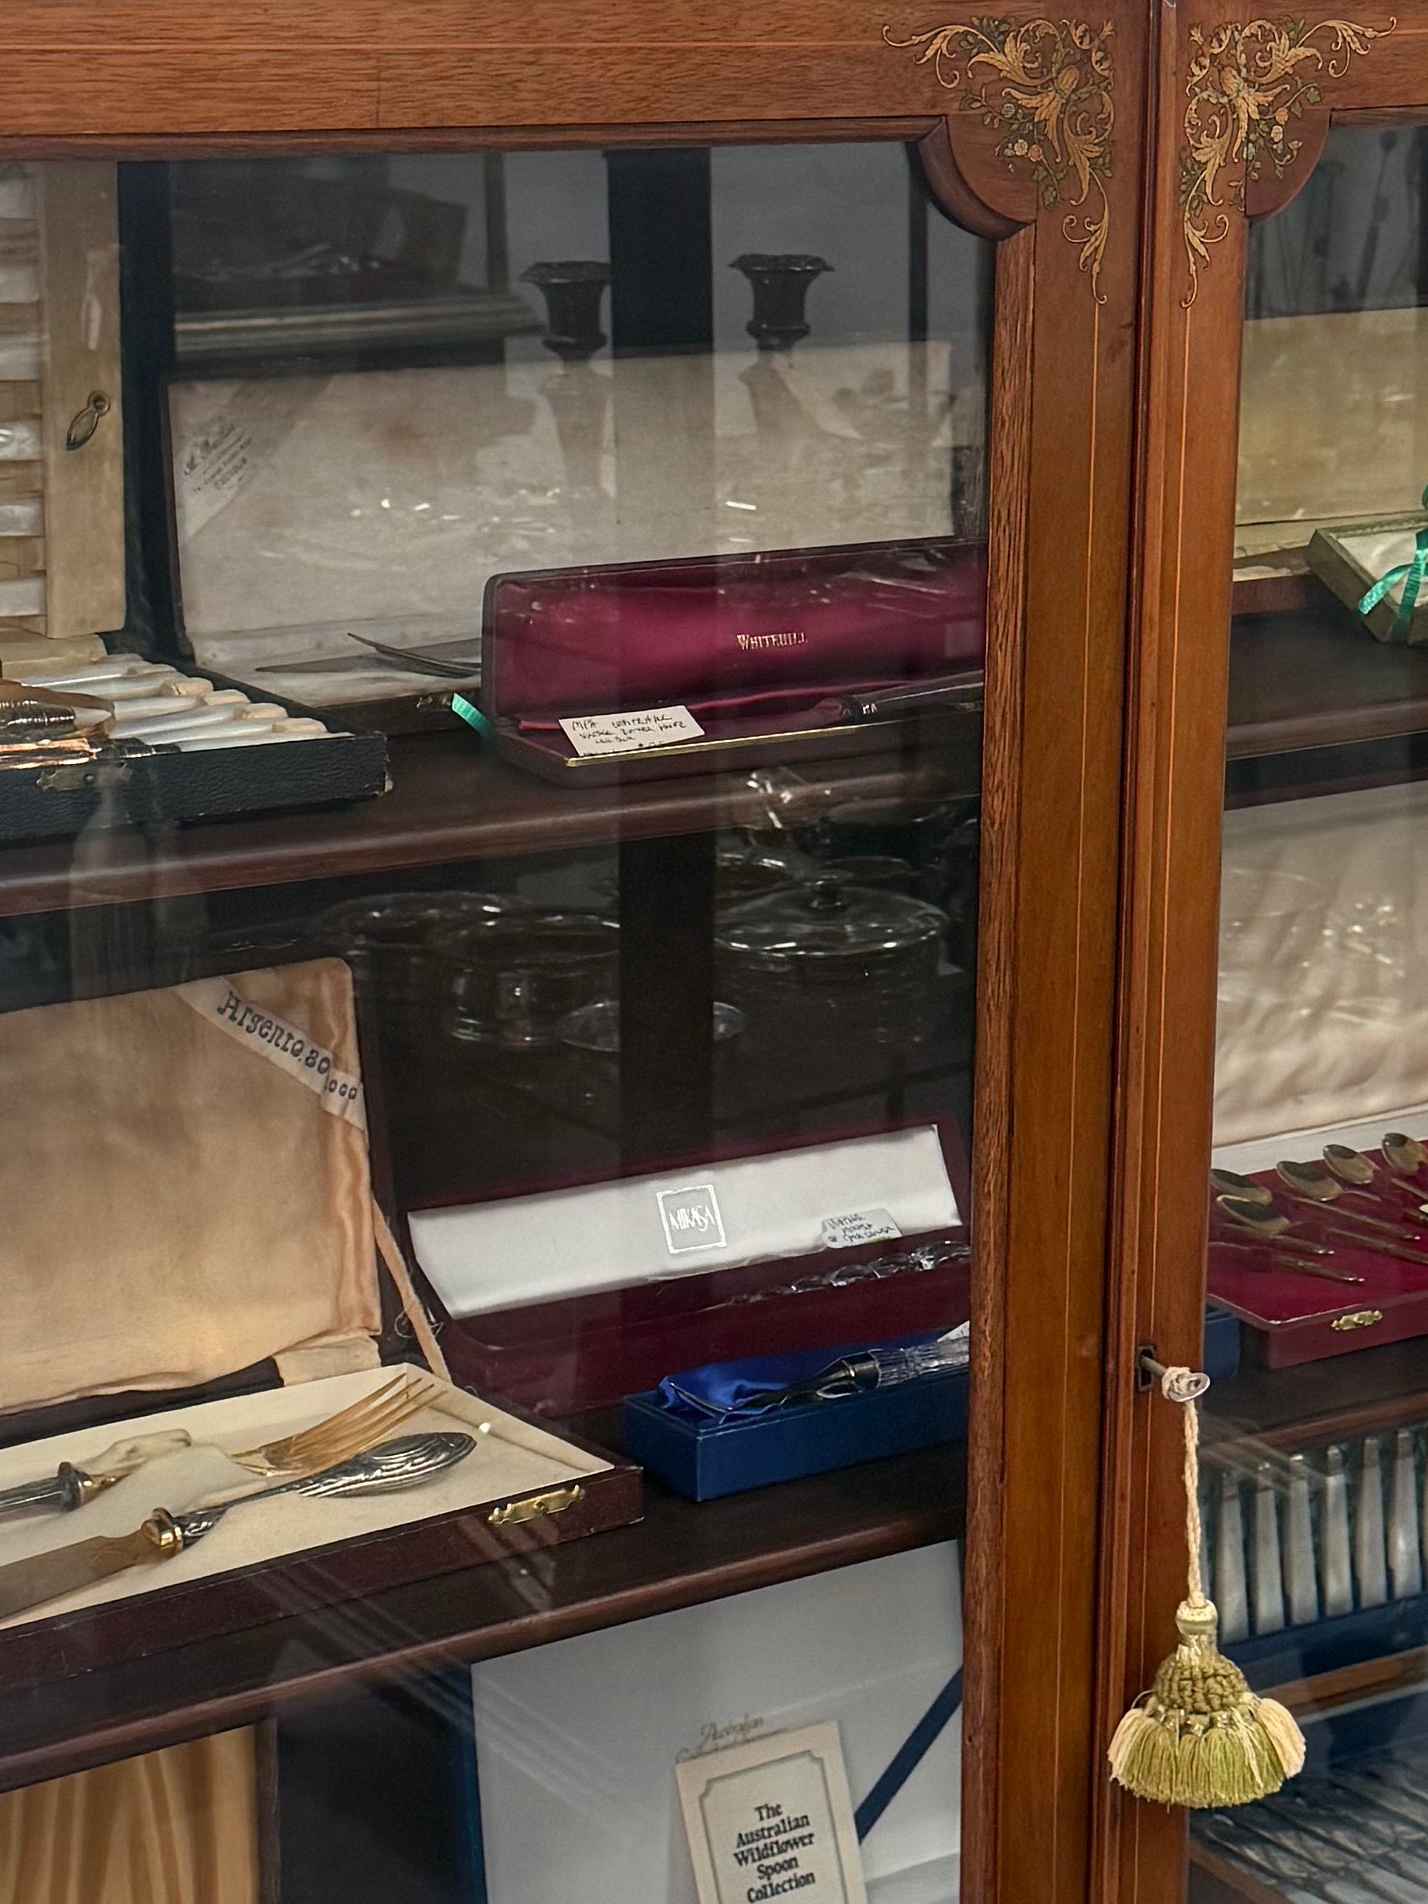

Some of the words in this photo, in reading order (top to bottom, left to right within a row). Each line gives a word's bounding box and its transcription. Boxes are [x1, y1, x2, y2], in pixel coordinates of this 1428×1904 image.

[668, 1204, 716, 1232] MIKASA
[753, 1803, 782, 1821] The
[737, 1814, 810, 1848] Australian
[733, 1832, 814, 1866] Wildflower
[757, 1856, 798, 1881] Spoon
[747, 1872, 815, 1903] Collection
